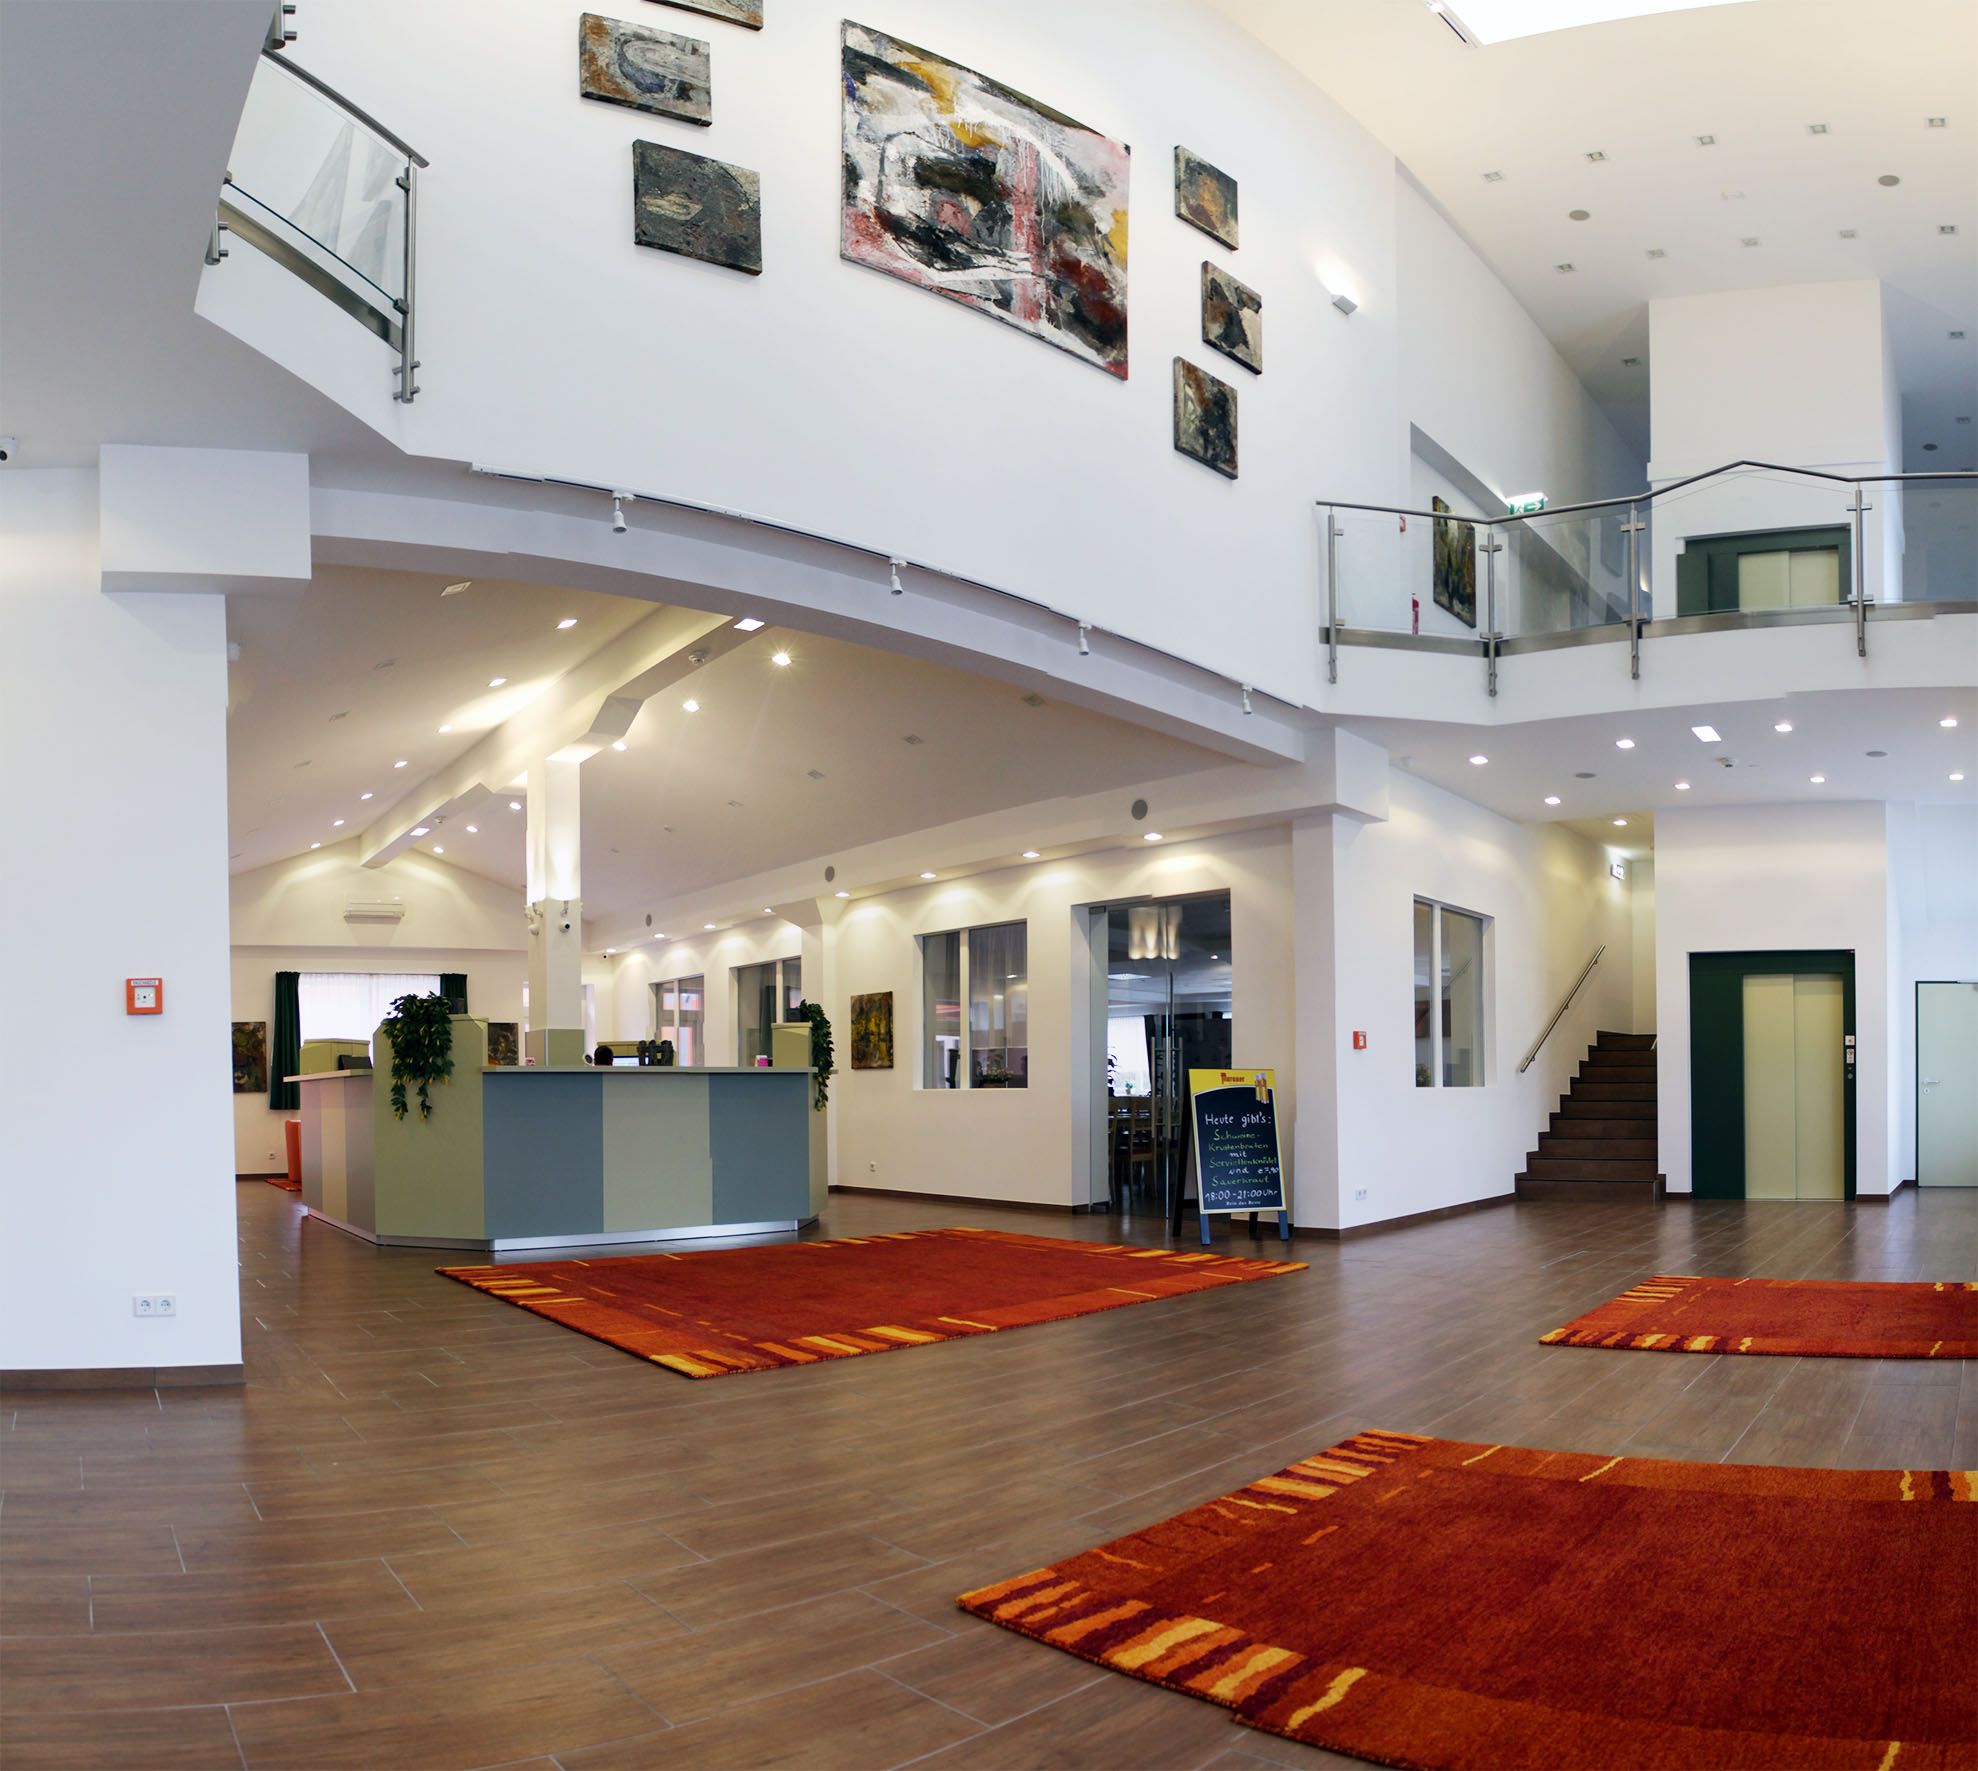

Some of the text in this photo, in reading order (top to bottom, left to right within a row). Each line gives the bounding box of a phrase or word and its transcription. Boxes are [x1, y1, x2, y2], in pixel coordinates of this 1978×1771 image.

[1205, 1113, 1234, 1125] Heute
[1229, 1150, 1248, 1158] mit
[1228, 1166, 1249, 1175] und
[1211, 1175, 1269, 1187] Sauerkraut
[1263, 1189, 1278, 1197] Uhr
